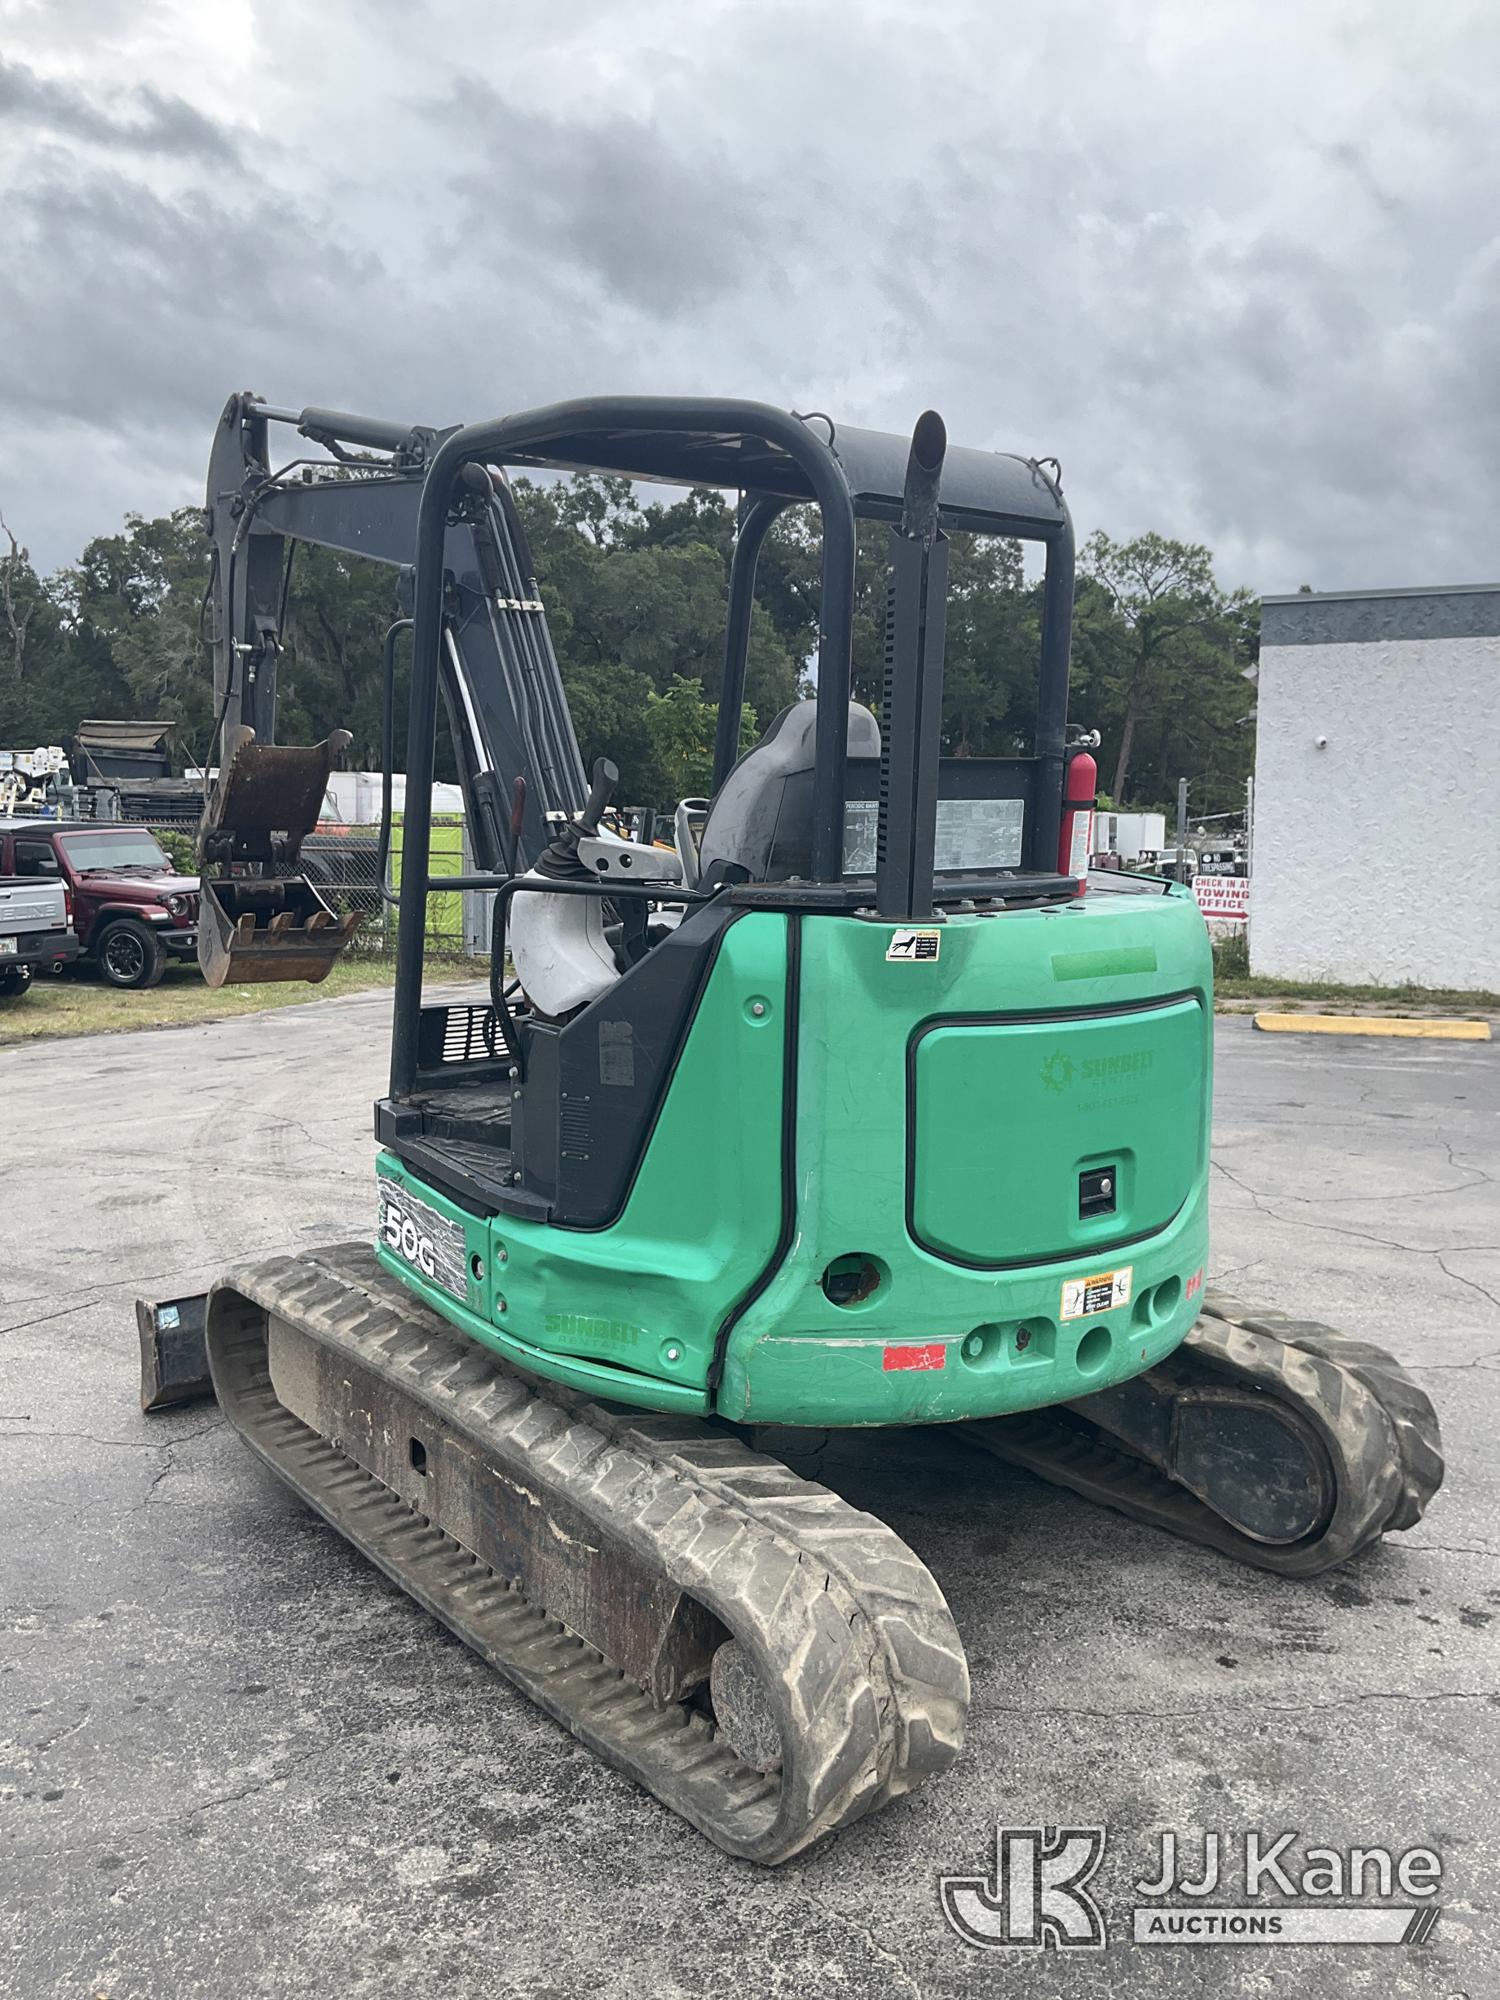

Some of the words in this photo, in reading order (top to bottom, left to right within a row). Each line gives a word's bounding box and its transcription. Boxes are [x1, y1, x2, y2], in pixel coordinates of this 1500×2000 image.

[1213, 854, 1222, 862] NO
[1202, 861, 1236, 873] TRESPASSING
[1195, 878, 1223, 887] CHECK
[1226, 879, 1236, 888] IN
[1240, 880, 1251, 889] AT
[1195, 888, 1251, 899] TOWING
[1198, 898, 1246, 909] OFFICE
[1080, 1050, 1154, 1079] SUNBELT
[386, 1204, 435, 1278] 50G
[544, 1315, 639, 1346] SUNBELT
